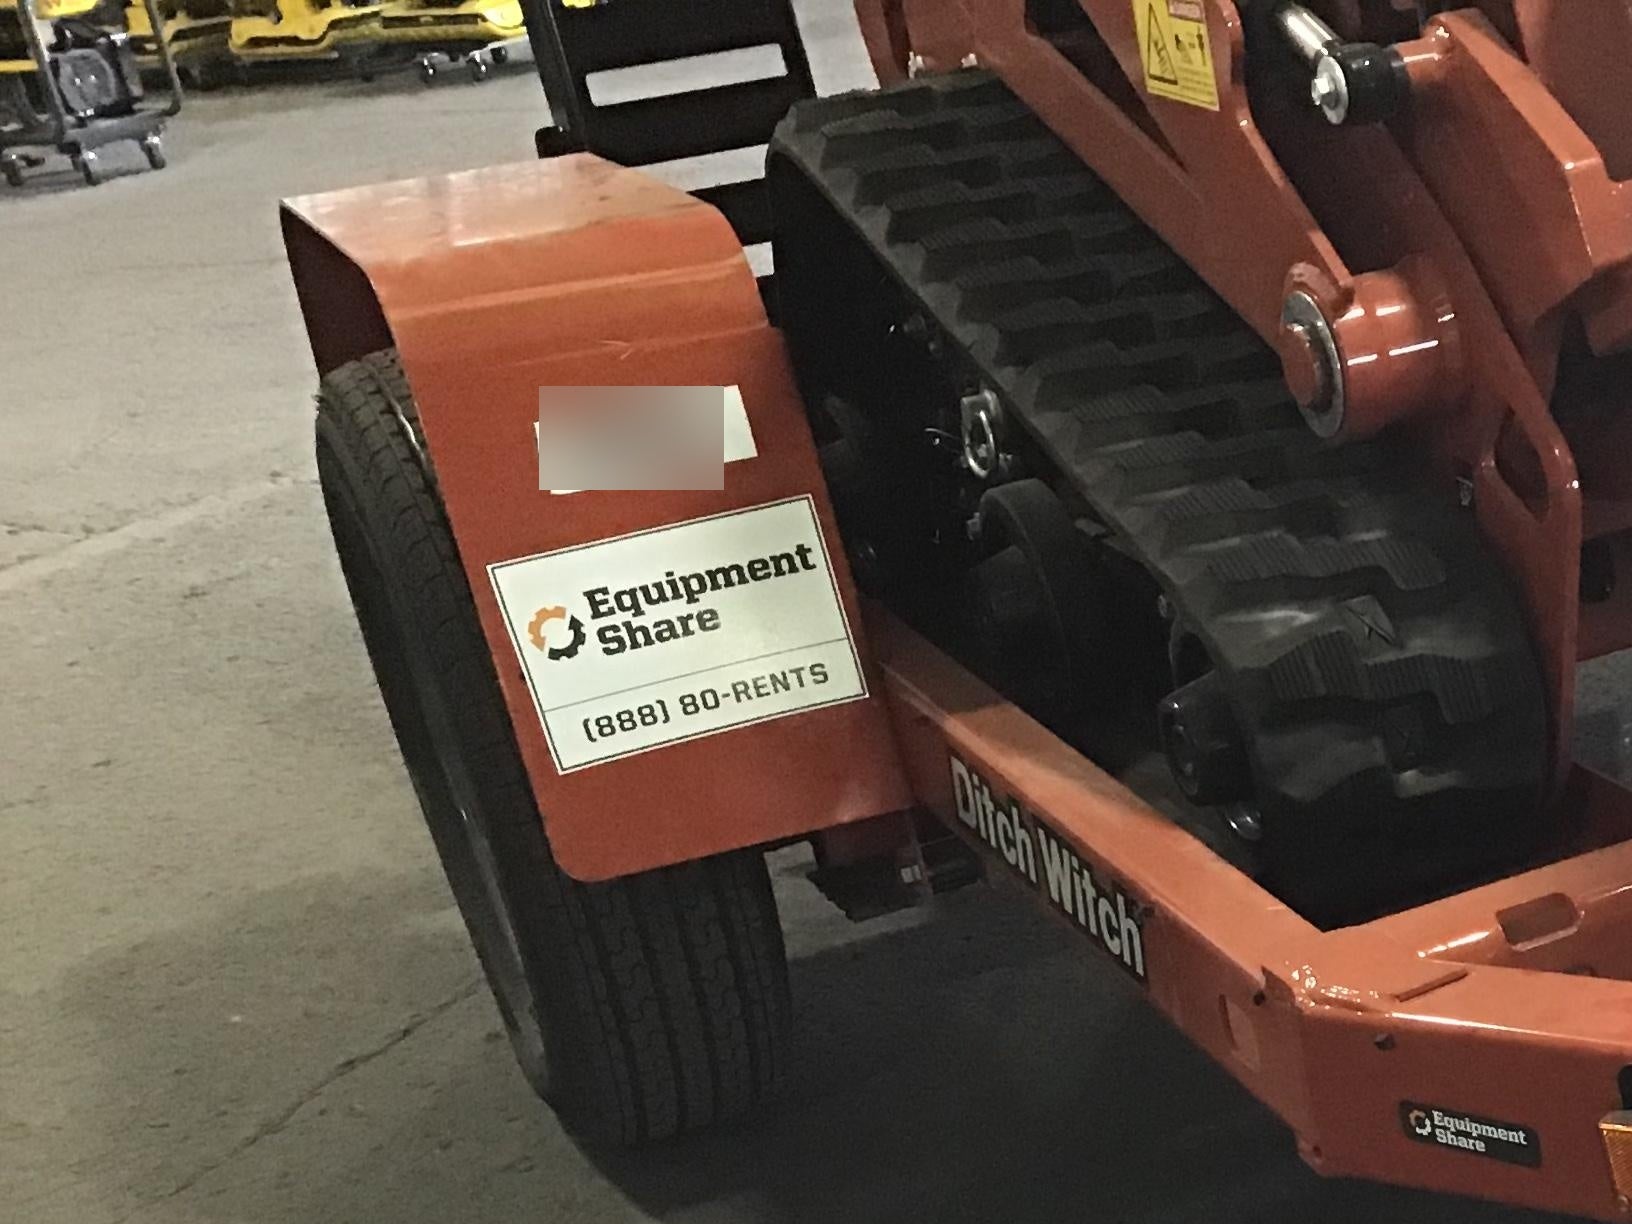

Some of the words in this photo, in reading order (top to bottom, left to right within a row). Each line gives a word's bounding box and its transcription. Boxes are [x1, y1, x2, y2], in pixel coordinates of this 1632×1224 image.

[583, 543, 817, 620] Equipment
[597, 608, 721, 656] Share
[583, 699, 670, 742] (888)
[679, 662, 829, 717] 80-RENTS
[950, 755, 1037, 883] Ditch
[1037, 826, 1144, 977] Witch
[1431, 1110, 1527, 1145] Equipment
[1435, 1128, 1486, 1152] Share
